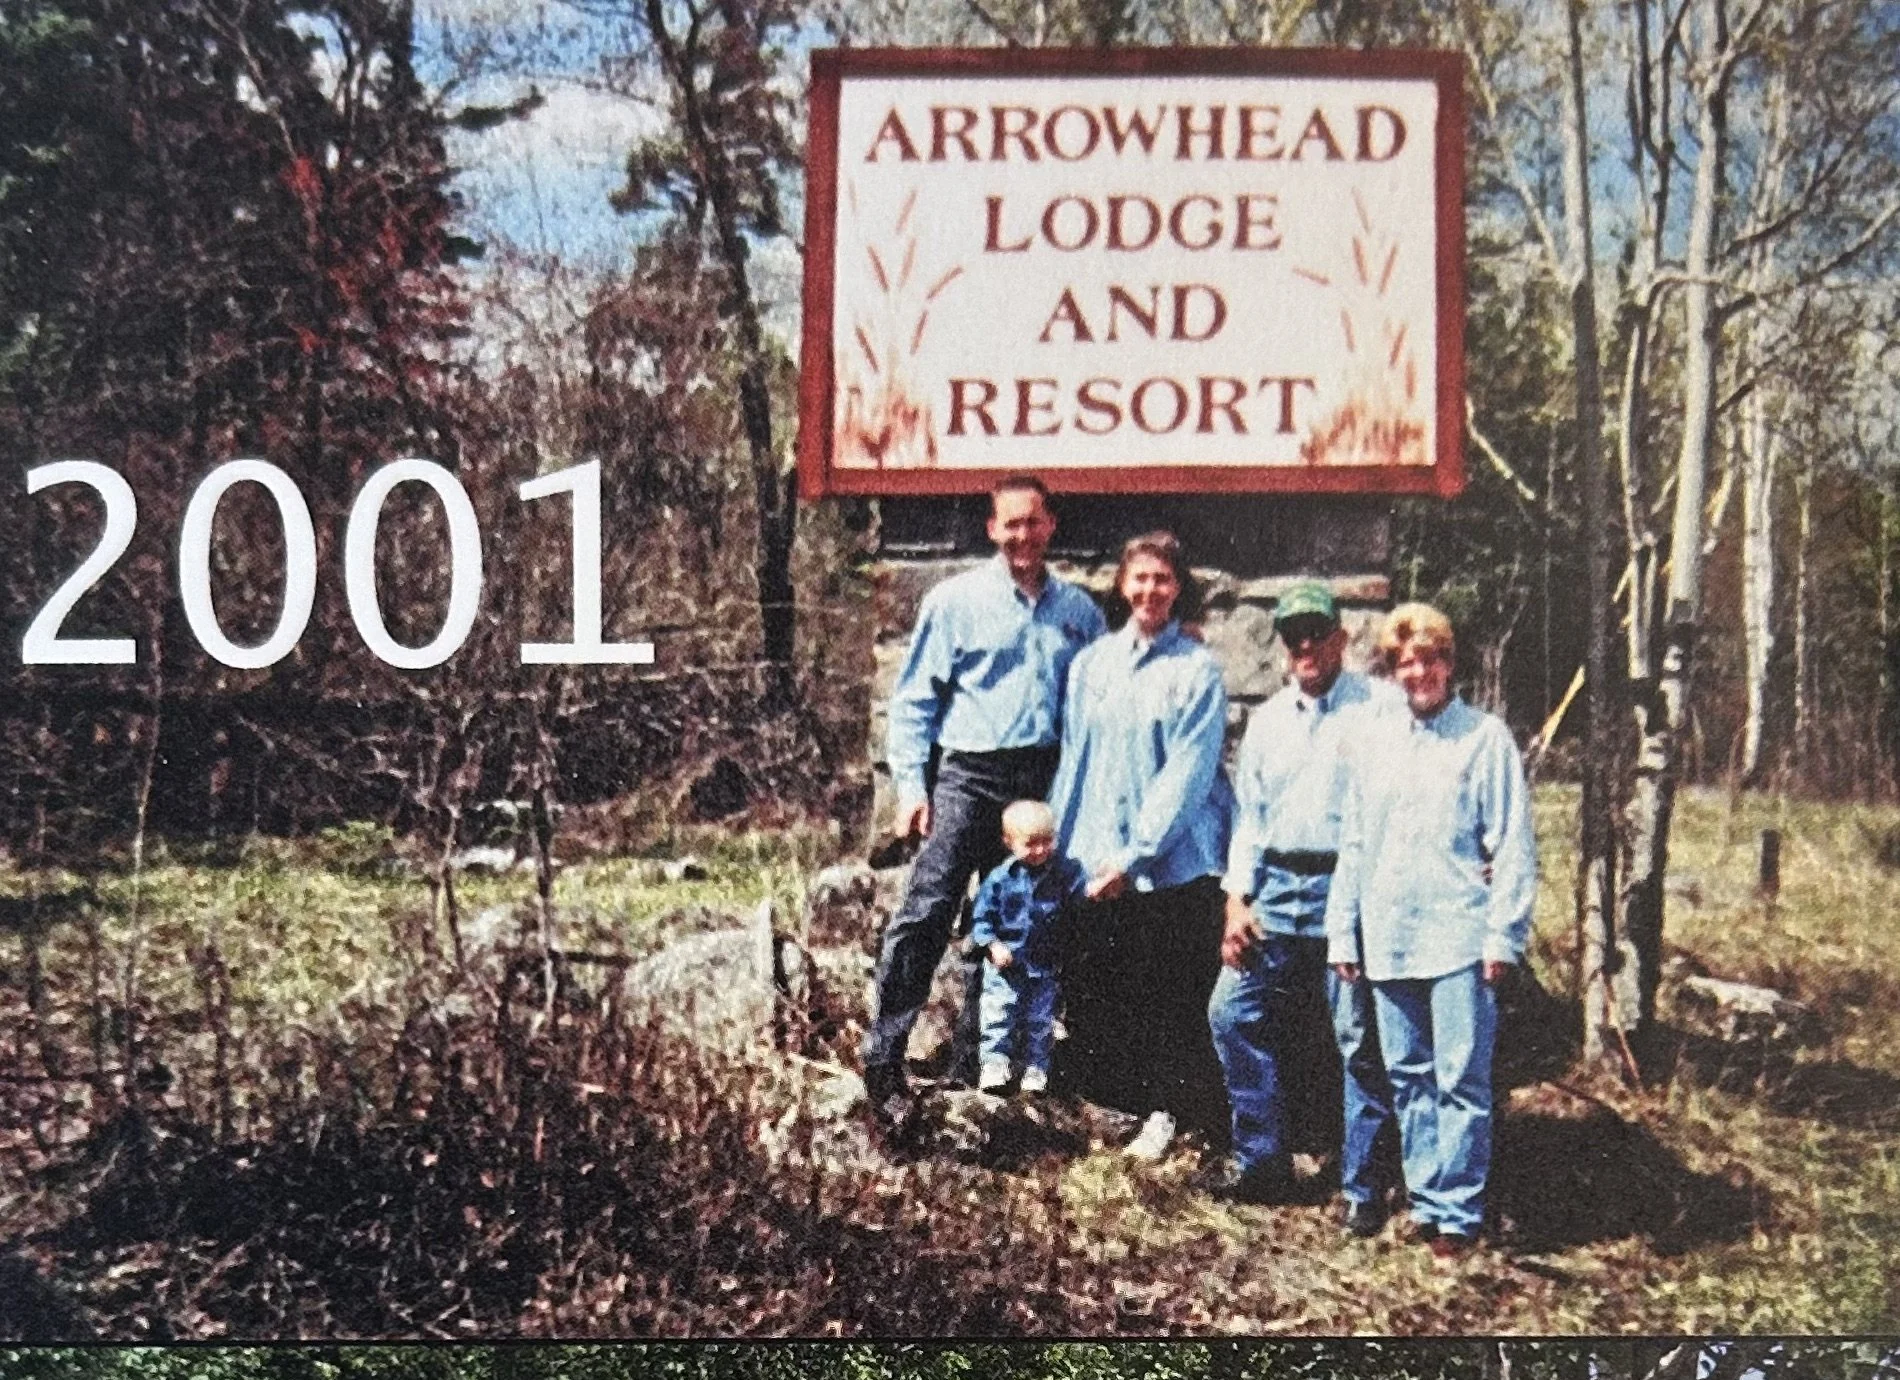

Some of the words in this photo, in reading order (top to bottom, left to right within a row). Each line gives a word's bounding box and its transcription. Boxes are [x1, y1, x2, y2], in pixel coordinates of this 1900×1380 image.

[865, 103, 1407, 163] ARROWHEAD
[983, 195, 1282, 253] LODGE
[1038, 283, 1228, 343] AND
[946, 376, 1317, 437] RESORT
